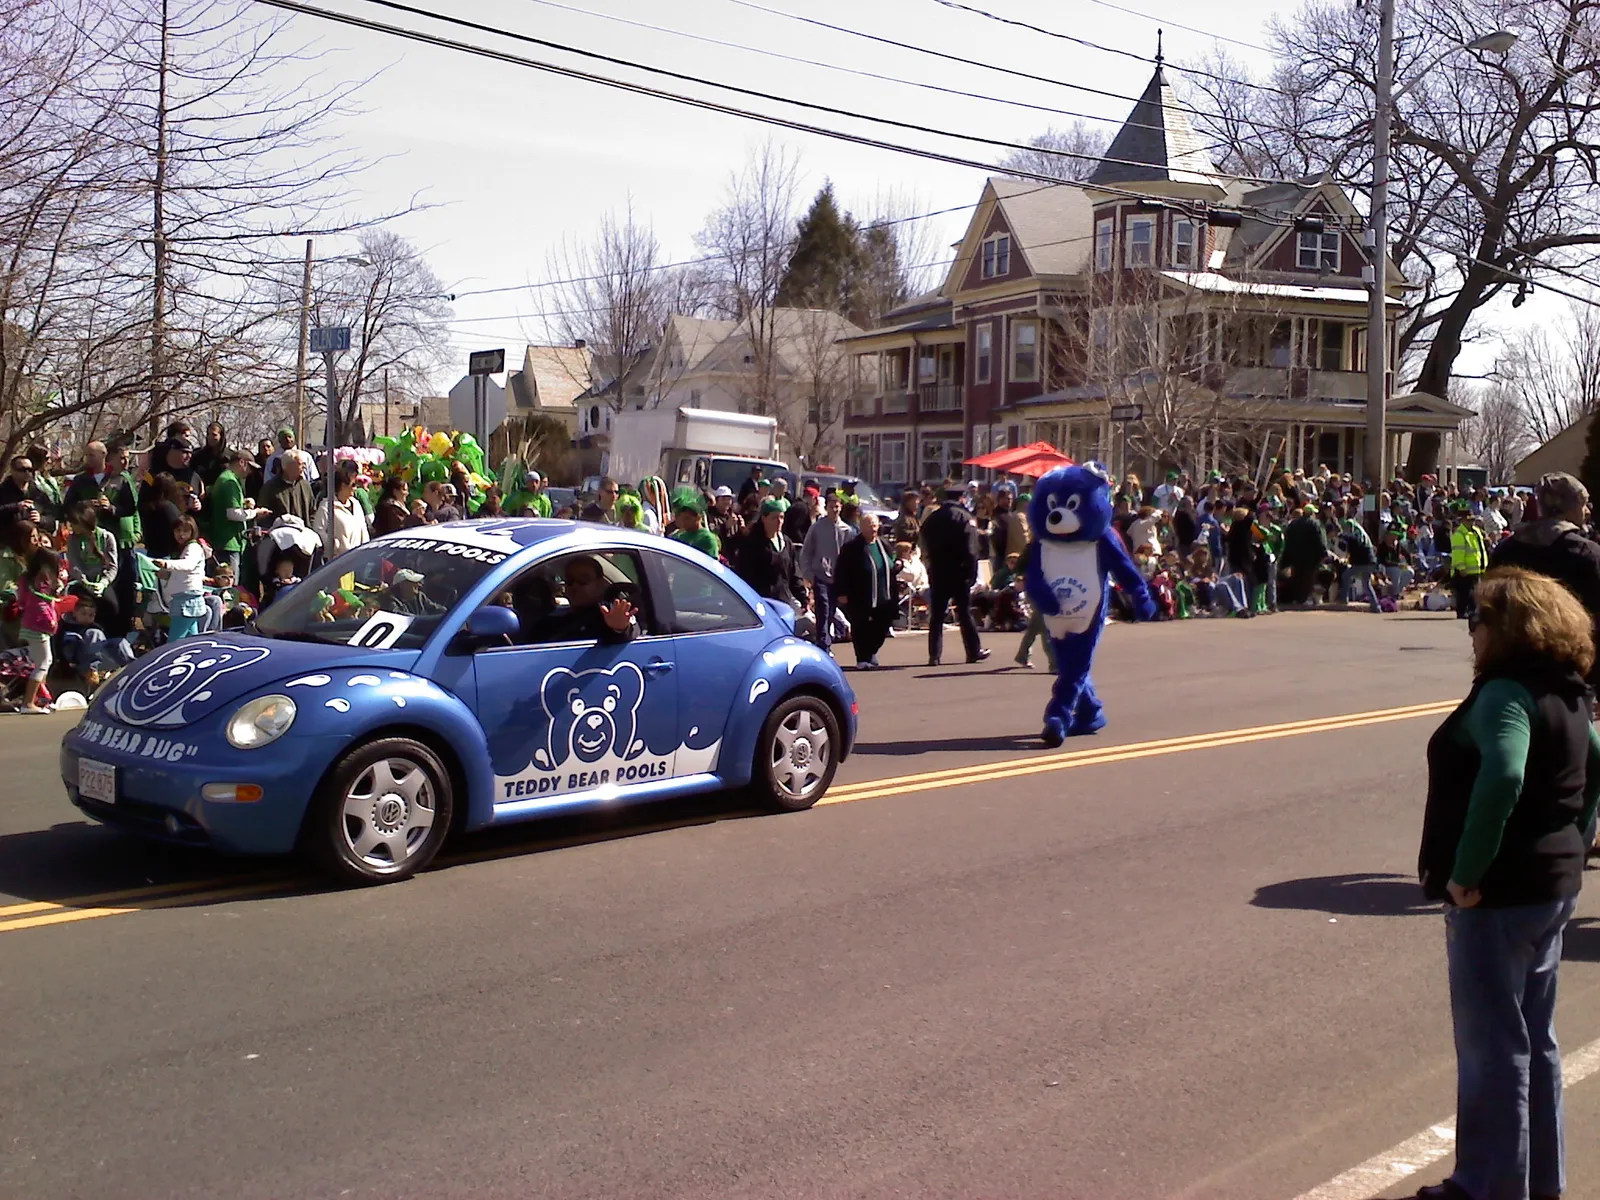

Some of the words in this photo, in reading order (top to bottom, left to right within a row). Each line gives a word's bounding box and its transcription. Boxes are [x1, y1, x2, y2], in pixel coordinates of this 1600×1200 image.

[337, 328, 349, 348] ST
[390, 540, 437, 556] BEAR
[434, 543, 506, 564] POOLS
[1050, 577, 1065, 589] DDY
[99, 727, 141, 753] BEAR
[505, 775, 561, 797] TEDDY
[568, 769, 610, 789] BEAR
[616, 761, 666, 781] POOLS
